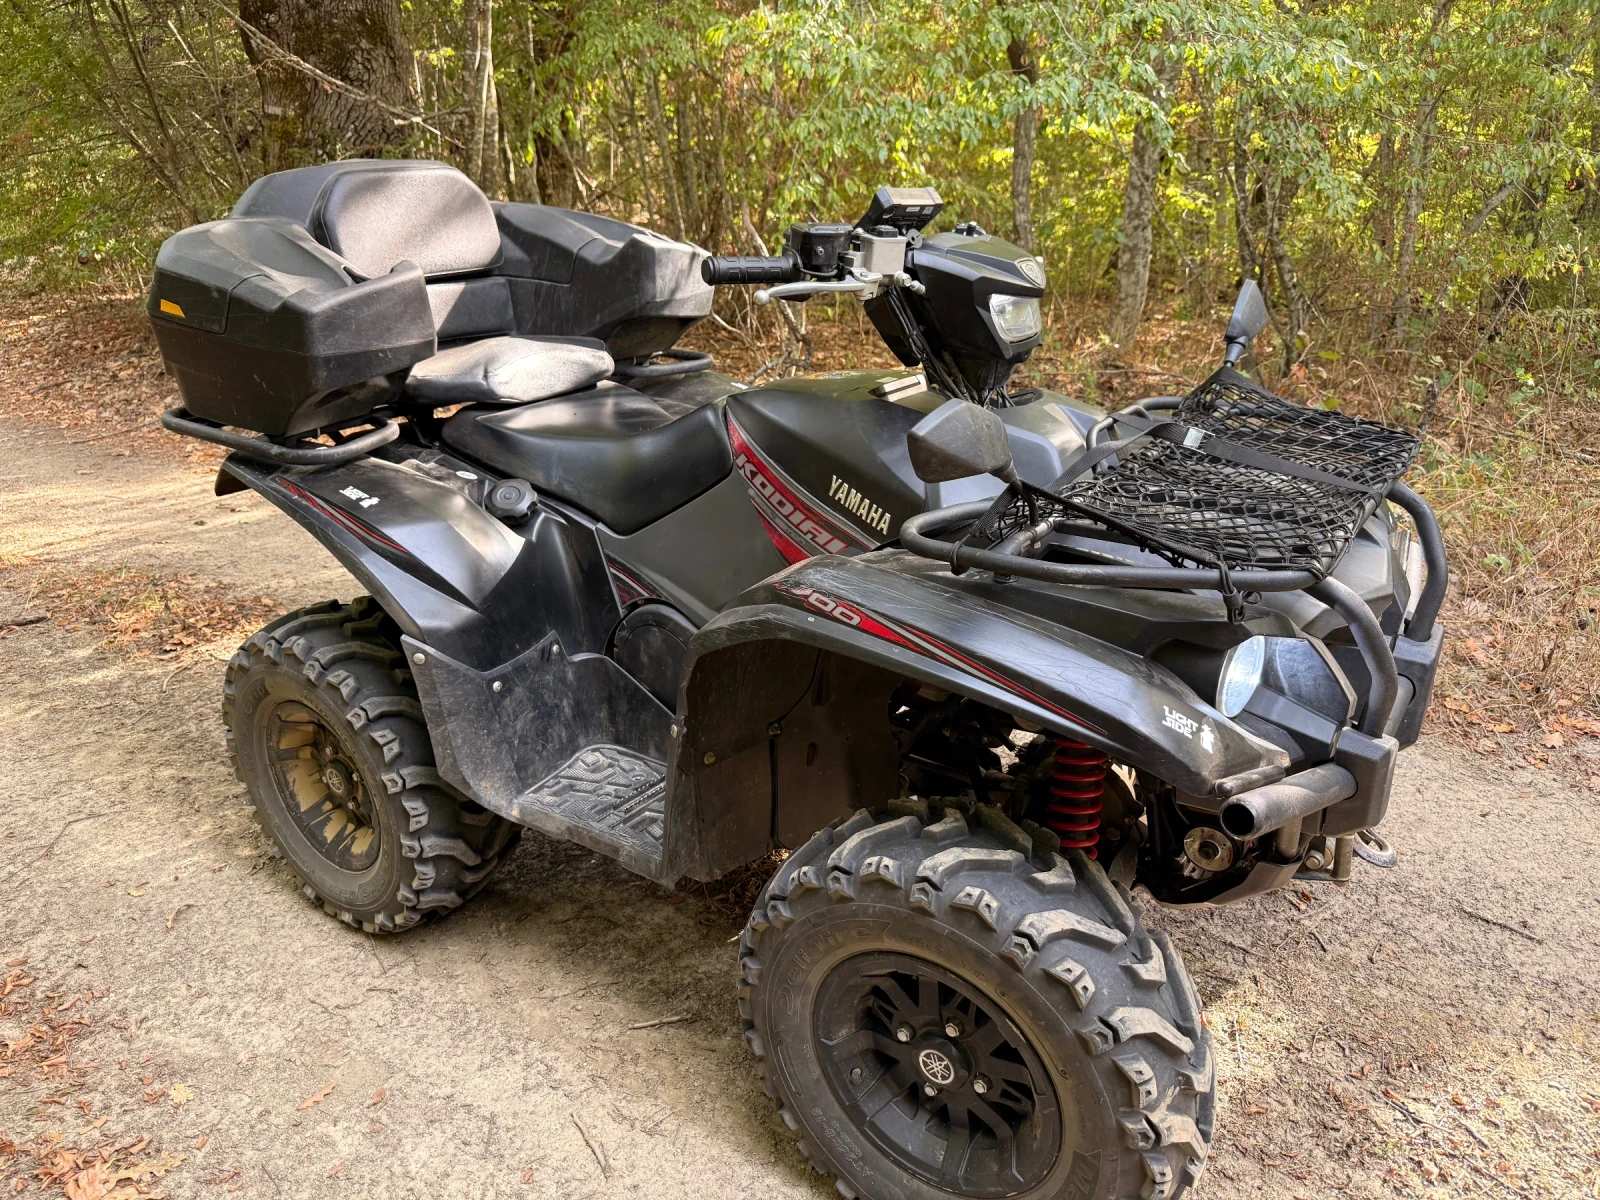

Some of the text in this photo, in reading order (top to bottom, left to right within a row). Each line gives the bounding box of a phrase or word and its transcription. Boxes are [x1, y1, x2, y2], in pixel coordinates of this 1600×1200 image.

[828, 474, 891, 535] YAMAHA
[1162, 716, 1193, 739] SIDE
[1163, 705, 1198, 732] LIGHT
[775, 927, 872, 1016] Deli Tire
